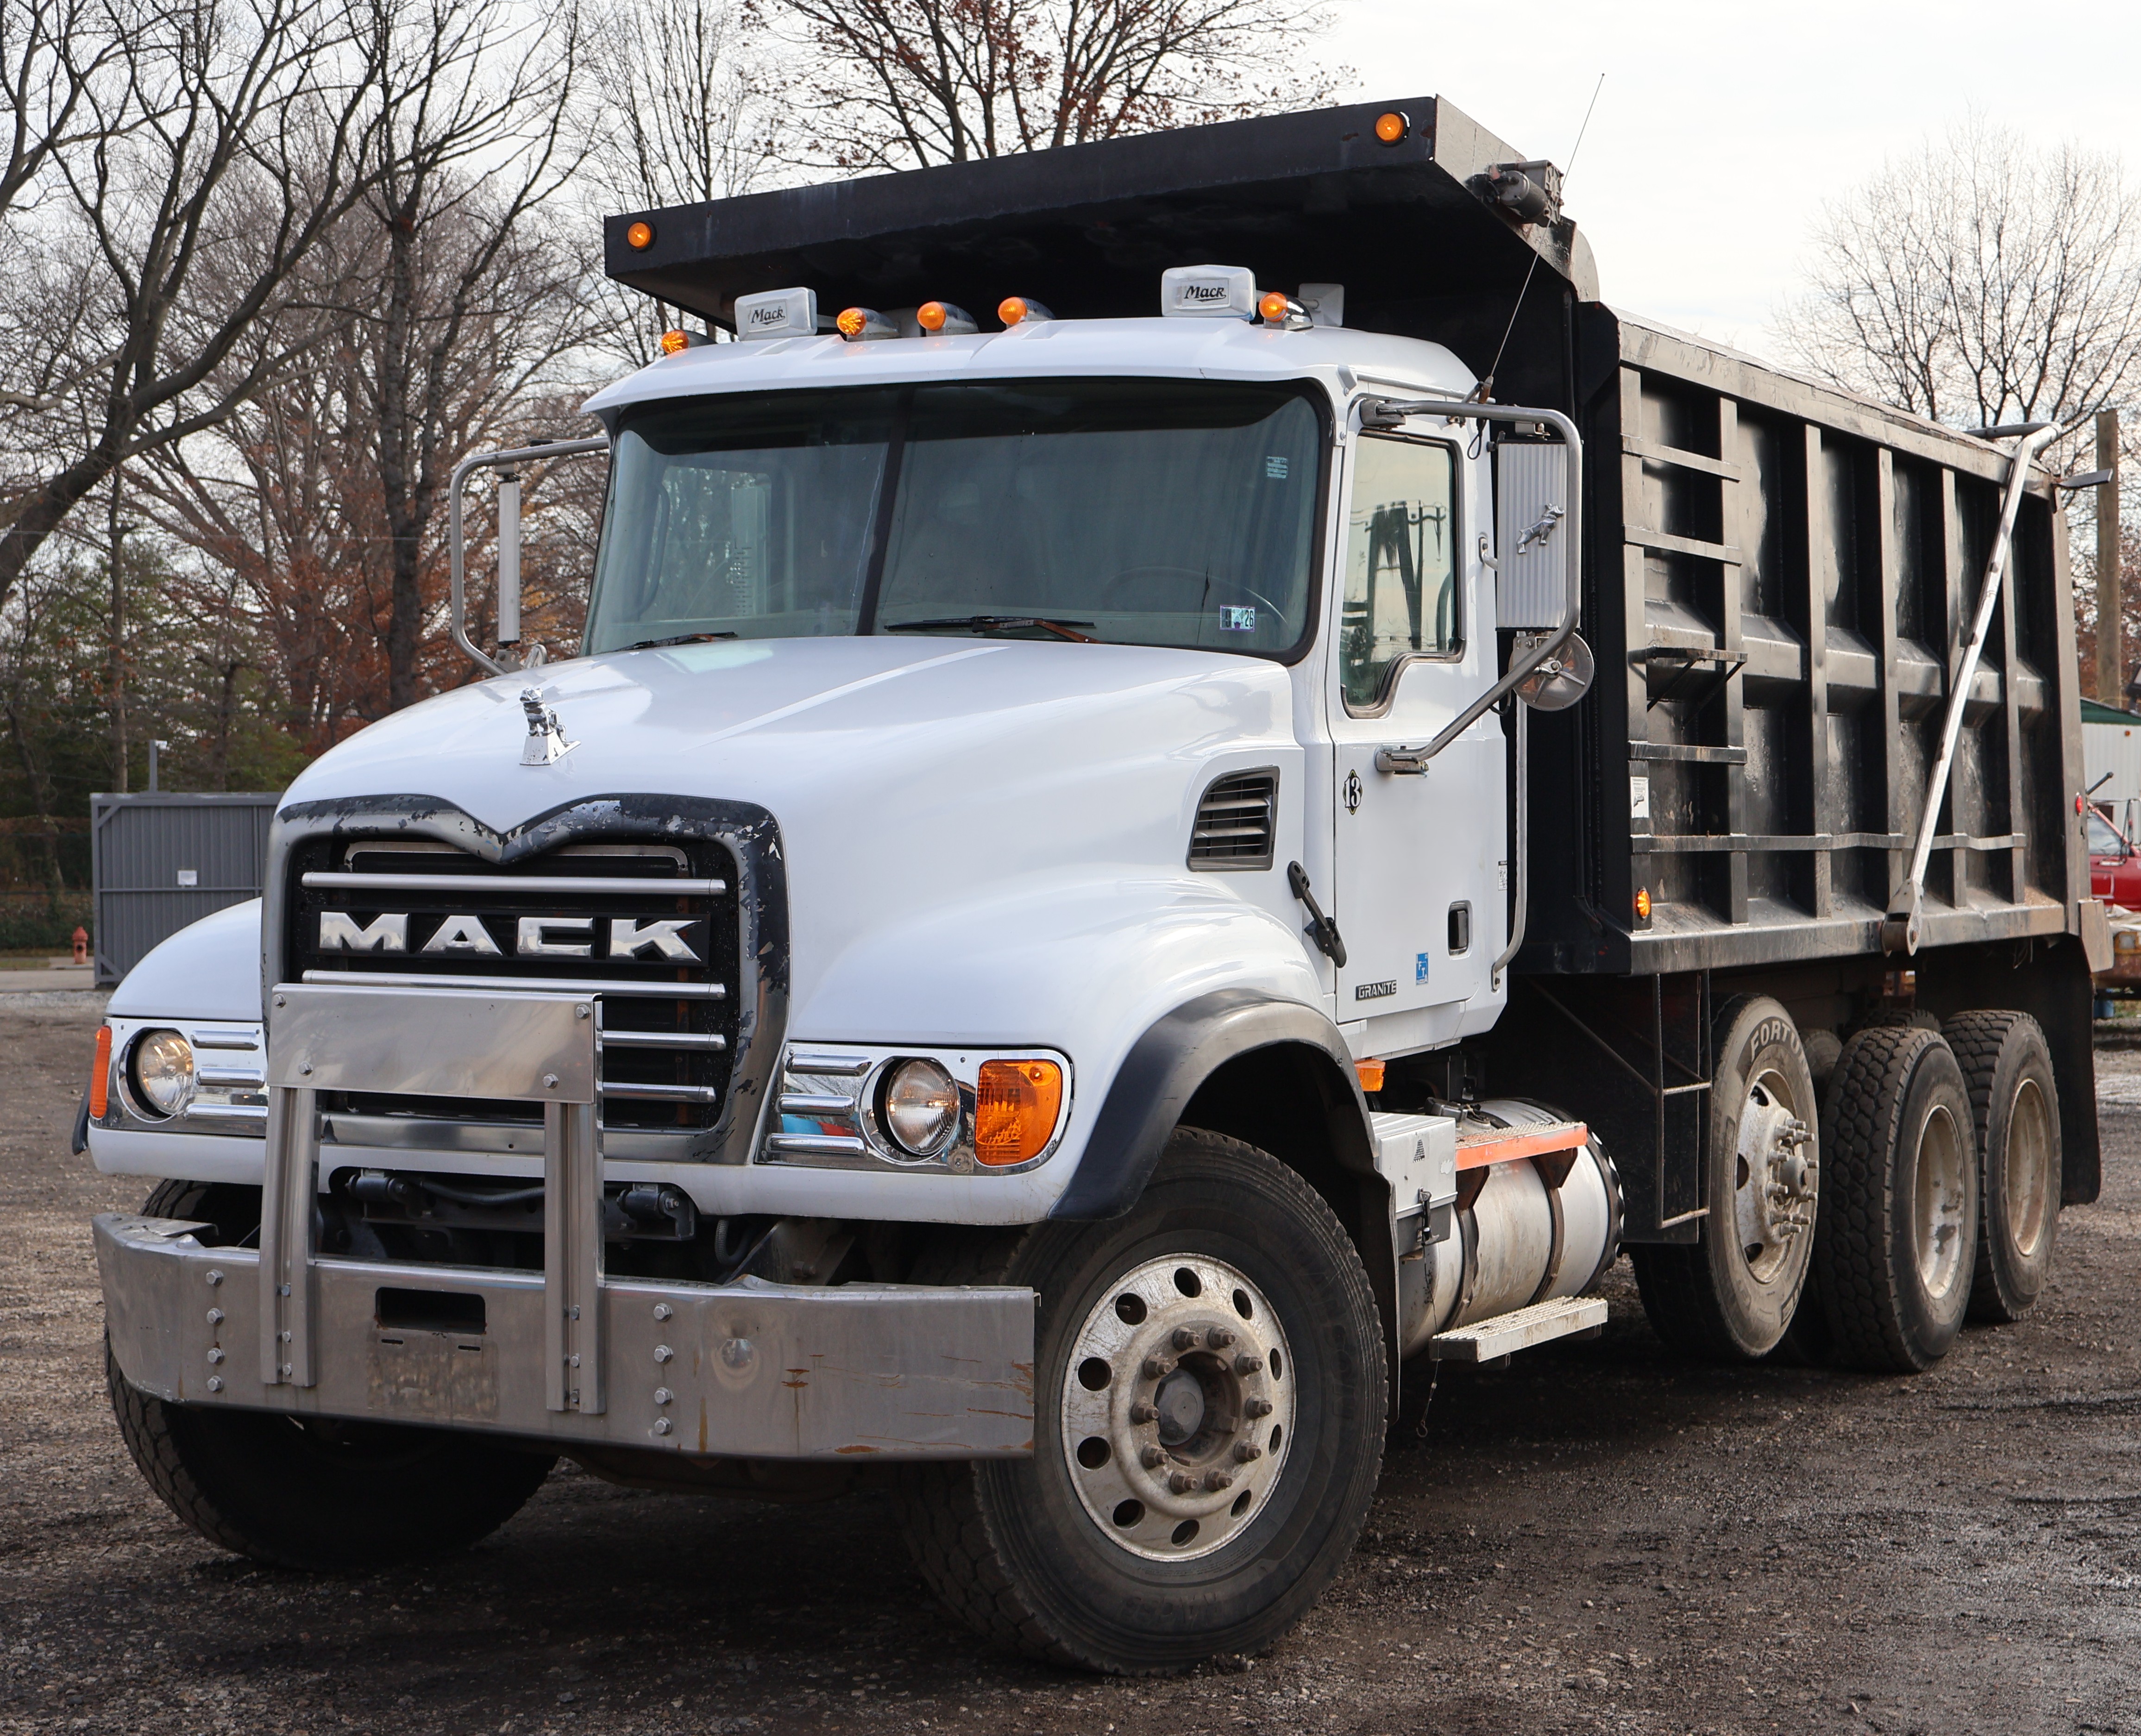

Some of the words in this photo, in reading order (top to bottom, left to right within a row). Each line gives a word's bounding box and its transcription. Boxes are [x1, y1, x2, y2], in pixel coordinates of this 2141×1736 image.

[1184, 286, 1226, 302] Mack
[751, 306, 785, 325] Mack
[1245, 610, 1254, 627] 26
[1344, 777, 1361, 807] 13
[320, 911, 702, 961] MACK
[1358, 982, 1397, 998] GRANITE
